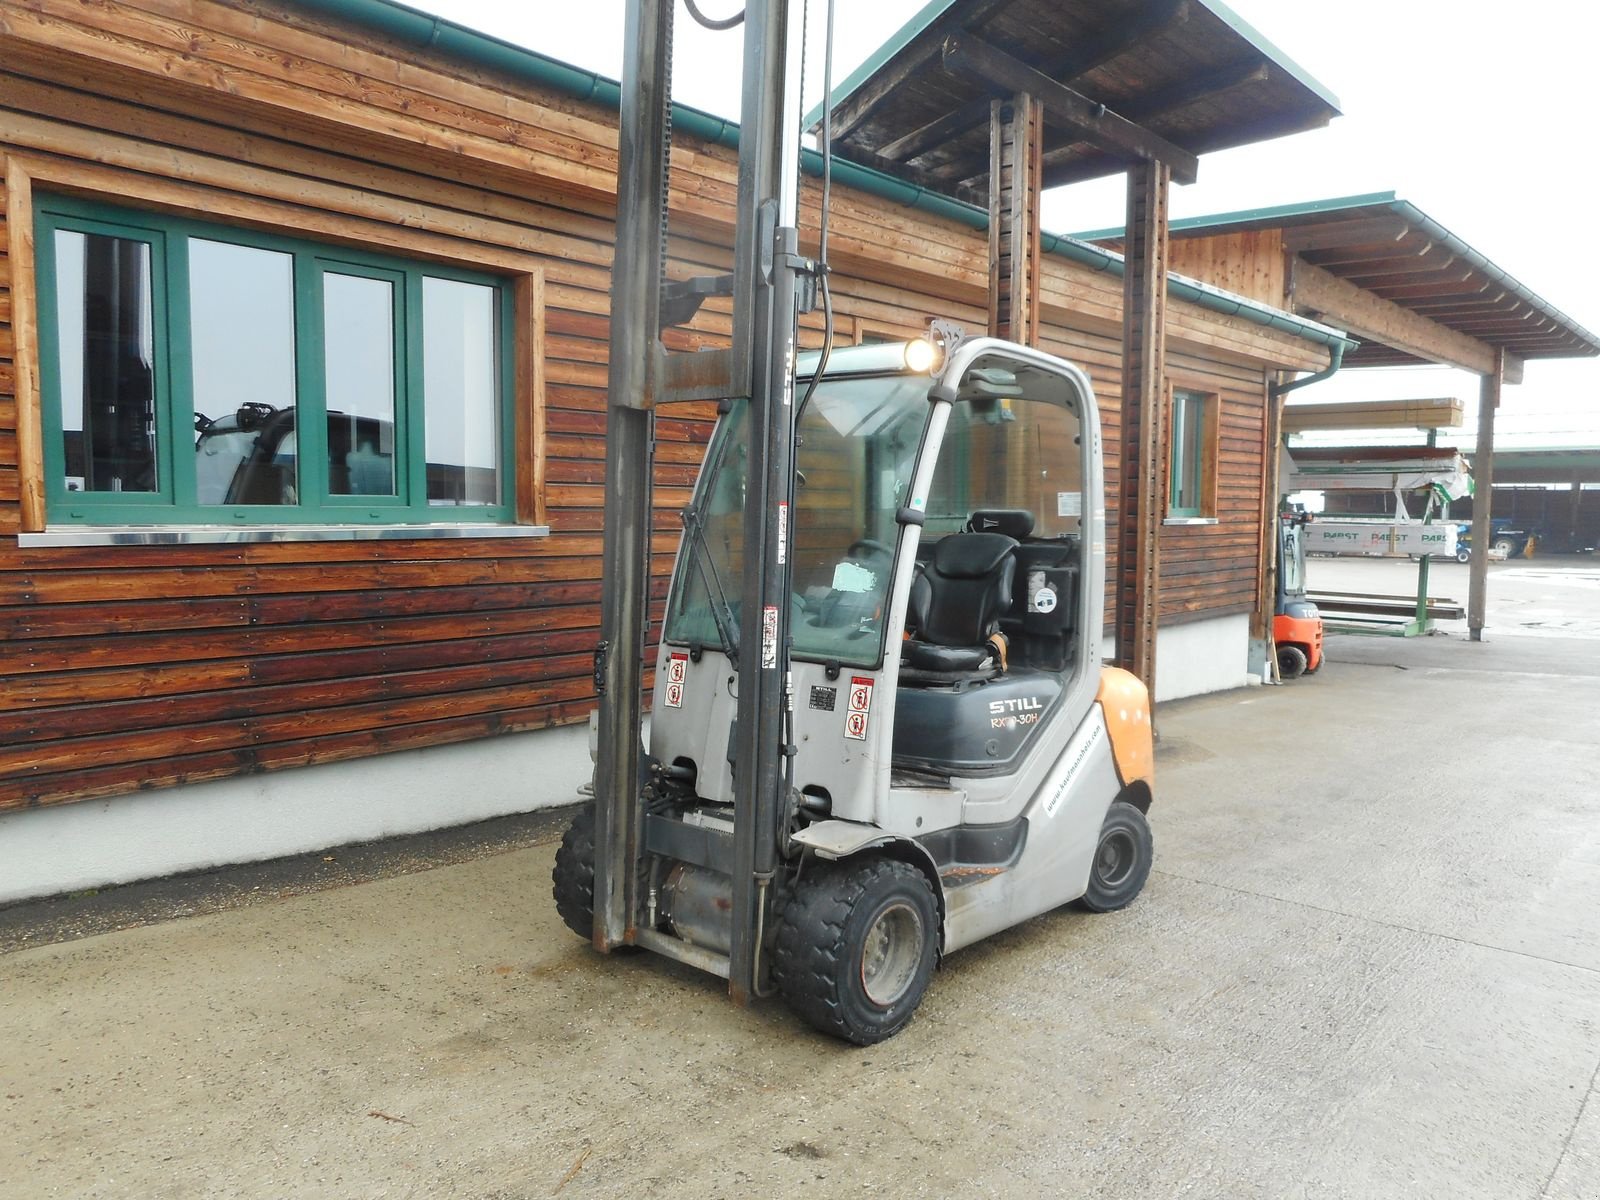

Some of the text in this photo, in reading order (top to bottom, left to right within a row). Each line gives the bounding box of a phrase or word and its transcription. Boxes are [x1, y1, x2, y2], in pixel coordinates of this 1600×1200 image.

[1323, 532, 1359, 540] PABST
[1371, 533, 1408, 542] PABST
[1421, 534, 1447, 542] PABS
[989, 696, 1042, 714] STILL
